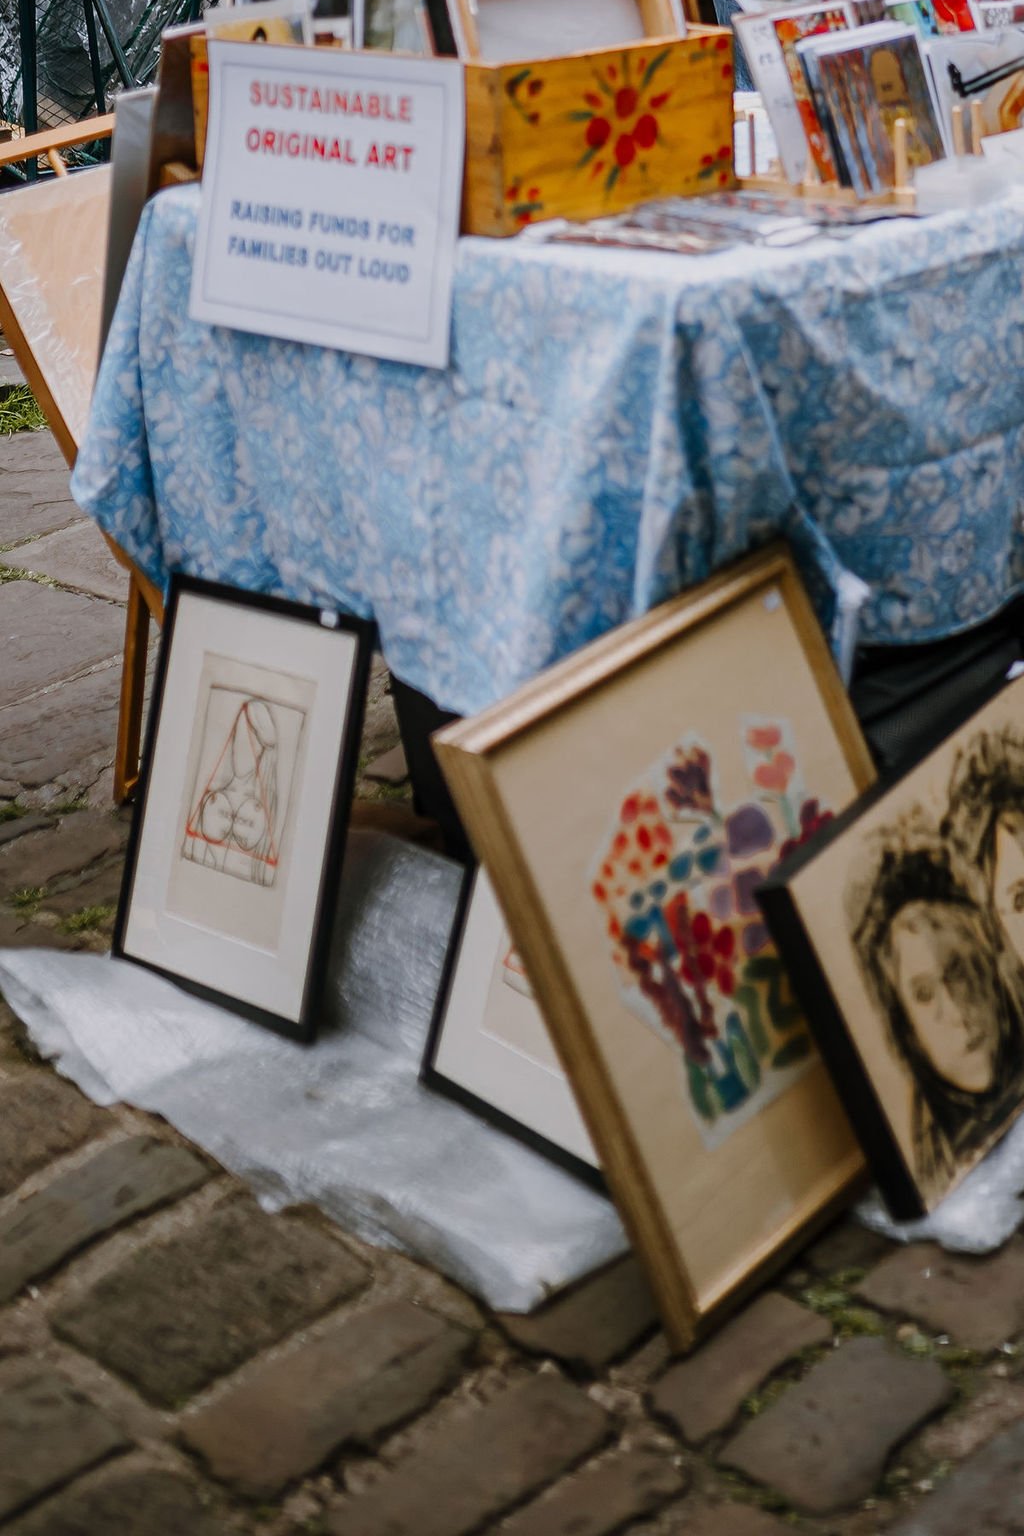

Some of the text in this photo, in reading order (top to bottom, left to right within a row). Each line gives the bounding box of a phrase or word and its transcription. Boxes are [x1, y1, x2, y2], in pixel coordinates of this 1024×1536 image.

[249, 80, 413, 123] SUSTAINABLE
[245, 128, 414, 172] ORIGINAL ART
[230, 199, 415, 247] RAISING FUNDS FOR
[227, 235, 410, 284] FAMILIES OUT LOUD
